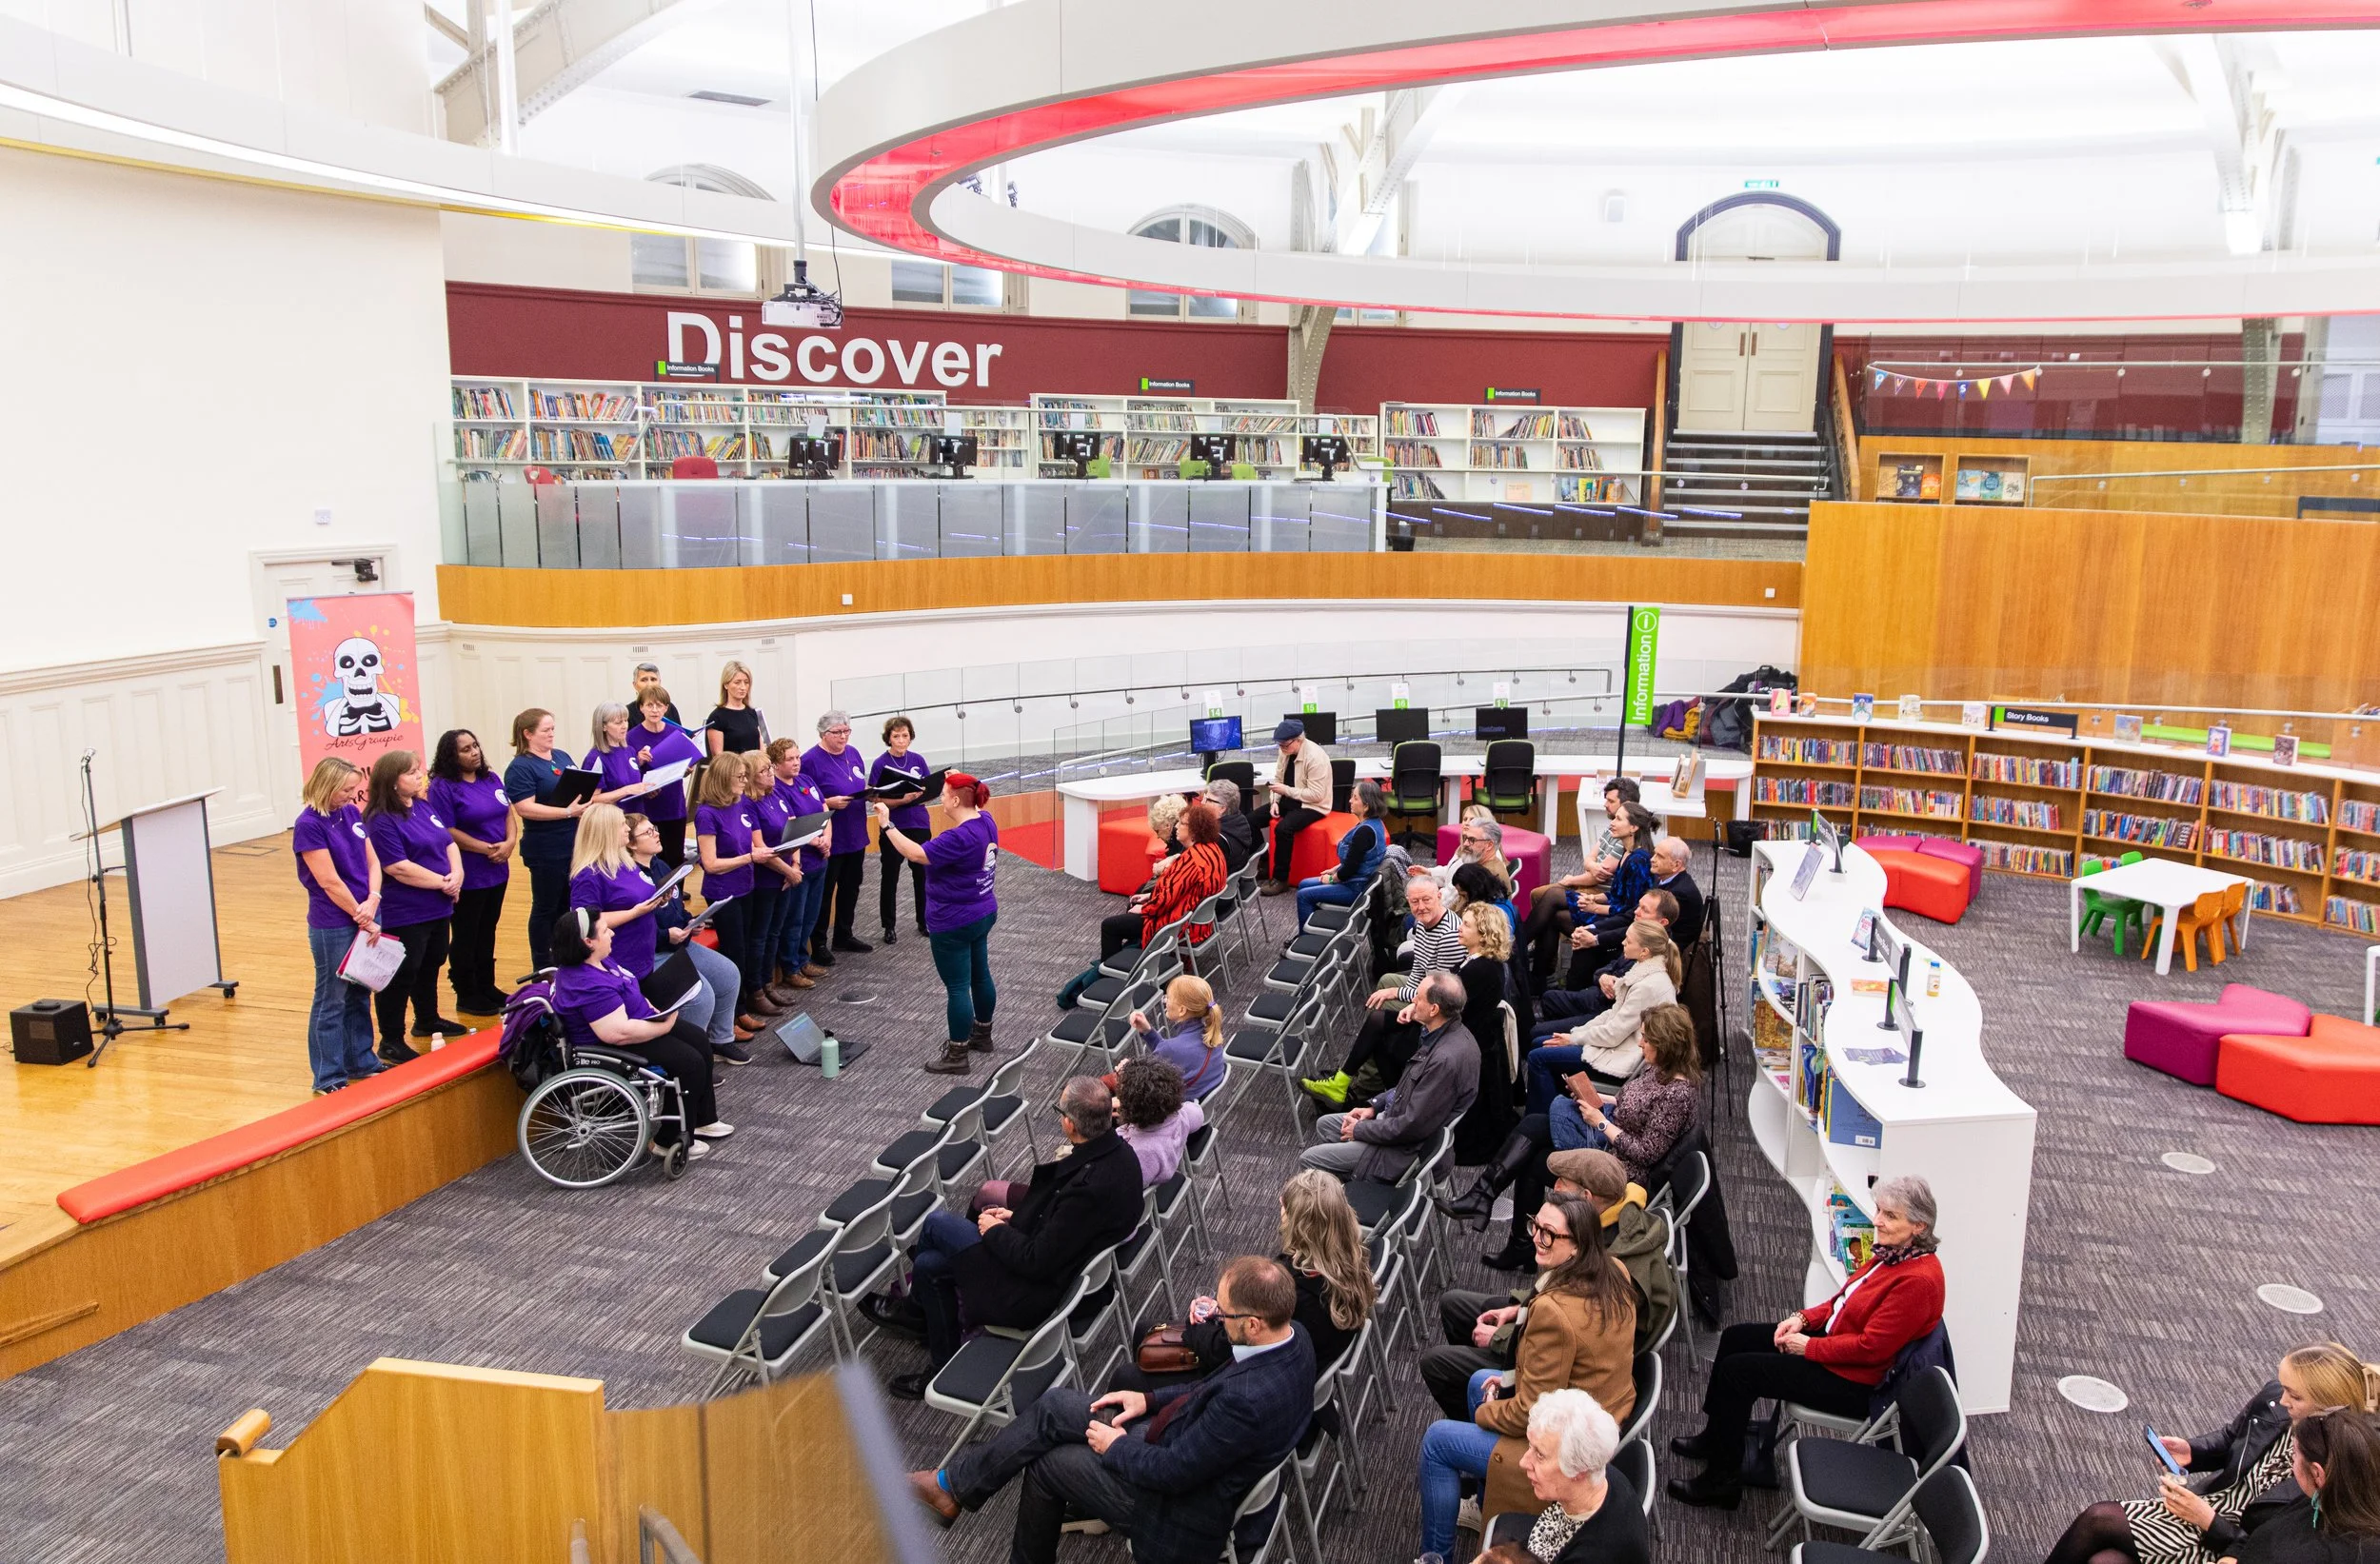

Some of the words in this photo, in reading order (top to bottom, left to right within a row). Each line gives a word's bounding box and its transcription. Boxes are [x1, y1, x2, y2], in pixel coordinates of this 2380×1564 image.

[667, 311, 1003, 387] Discover
[666, 364, 698, 372] Information
[1632, 634, 1653, 721] Information
[1210, 708, 1221, 717] 14
[2006, 711, 2026, 722] Story
[2026, 713, 2050, 723] Books
